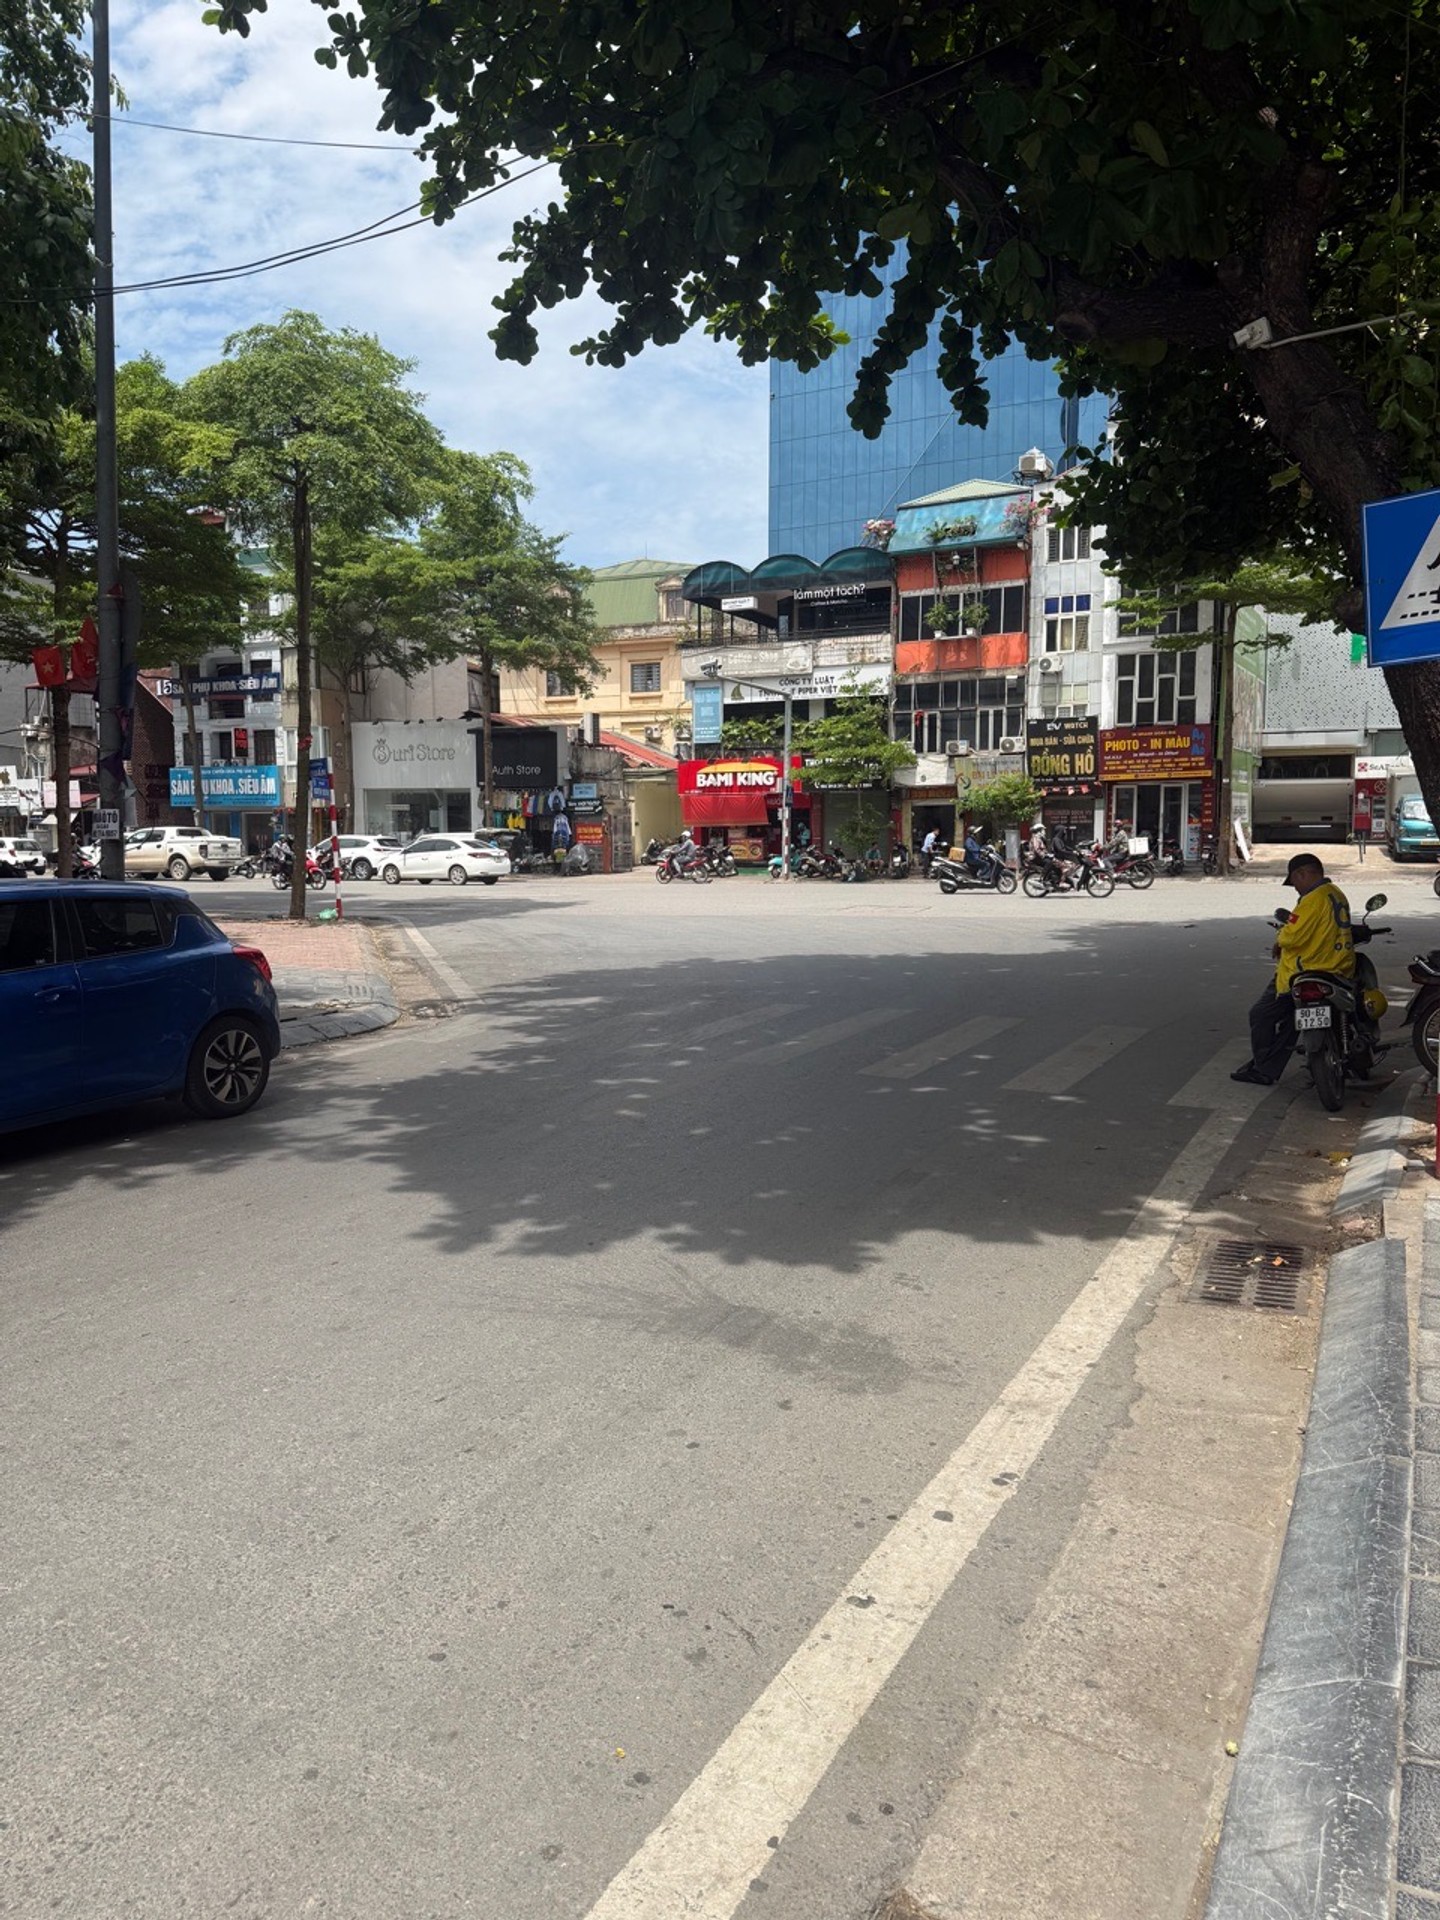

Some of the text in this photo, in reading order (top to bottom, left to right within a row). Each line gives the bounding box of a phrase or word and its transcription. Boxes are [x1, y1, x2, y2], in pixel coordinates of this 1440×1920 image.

[1105, 739, 1140, 752] PHOTO
[1150, 737, 1162, 750] IN
[1165, 734, 1191, 749] MÀU
[416, 743, 456, 762] Store
[1031, 747, 1071, 777] ĐỒNG
[1074, 745, 1095, 775] HỒ
[515, 764, 542, 776] Store
[695, 770, 776, 788] BAMI KING
[170, 774, 190, 795] SẢN
[238, 775, 259, 795] SIÊU
[260, 773, 276, 795] ÂM
